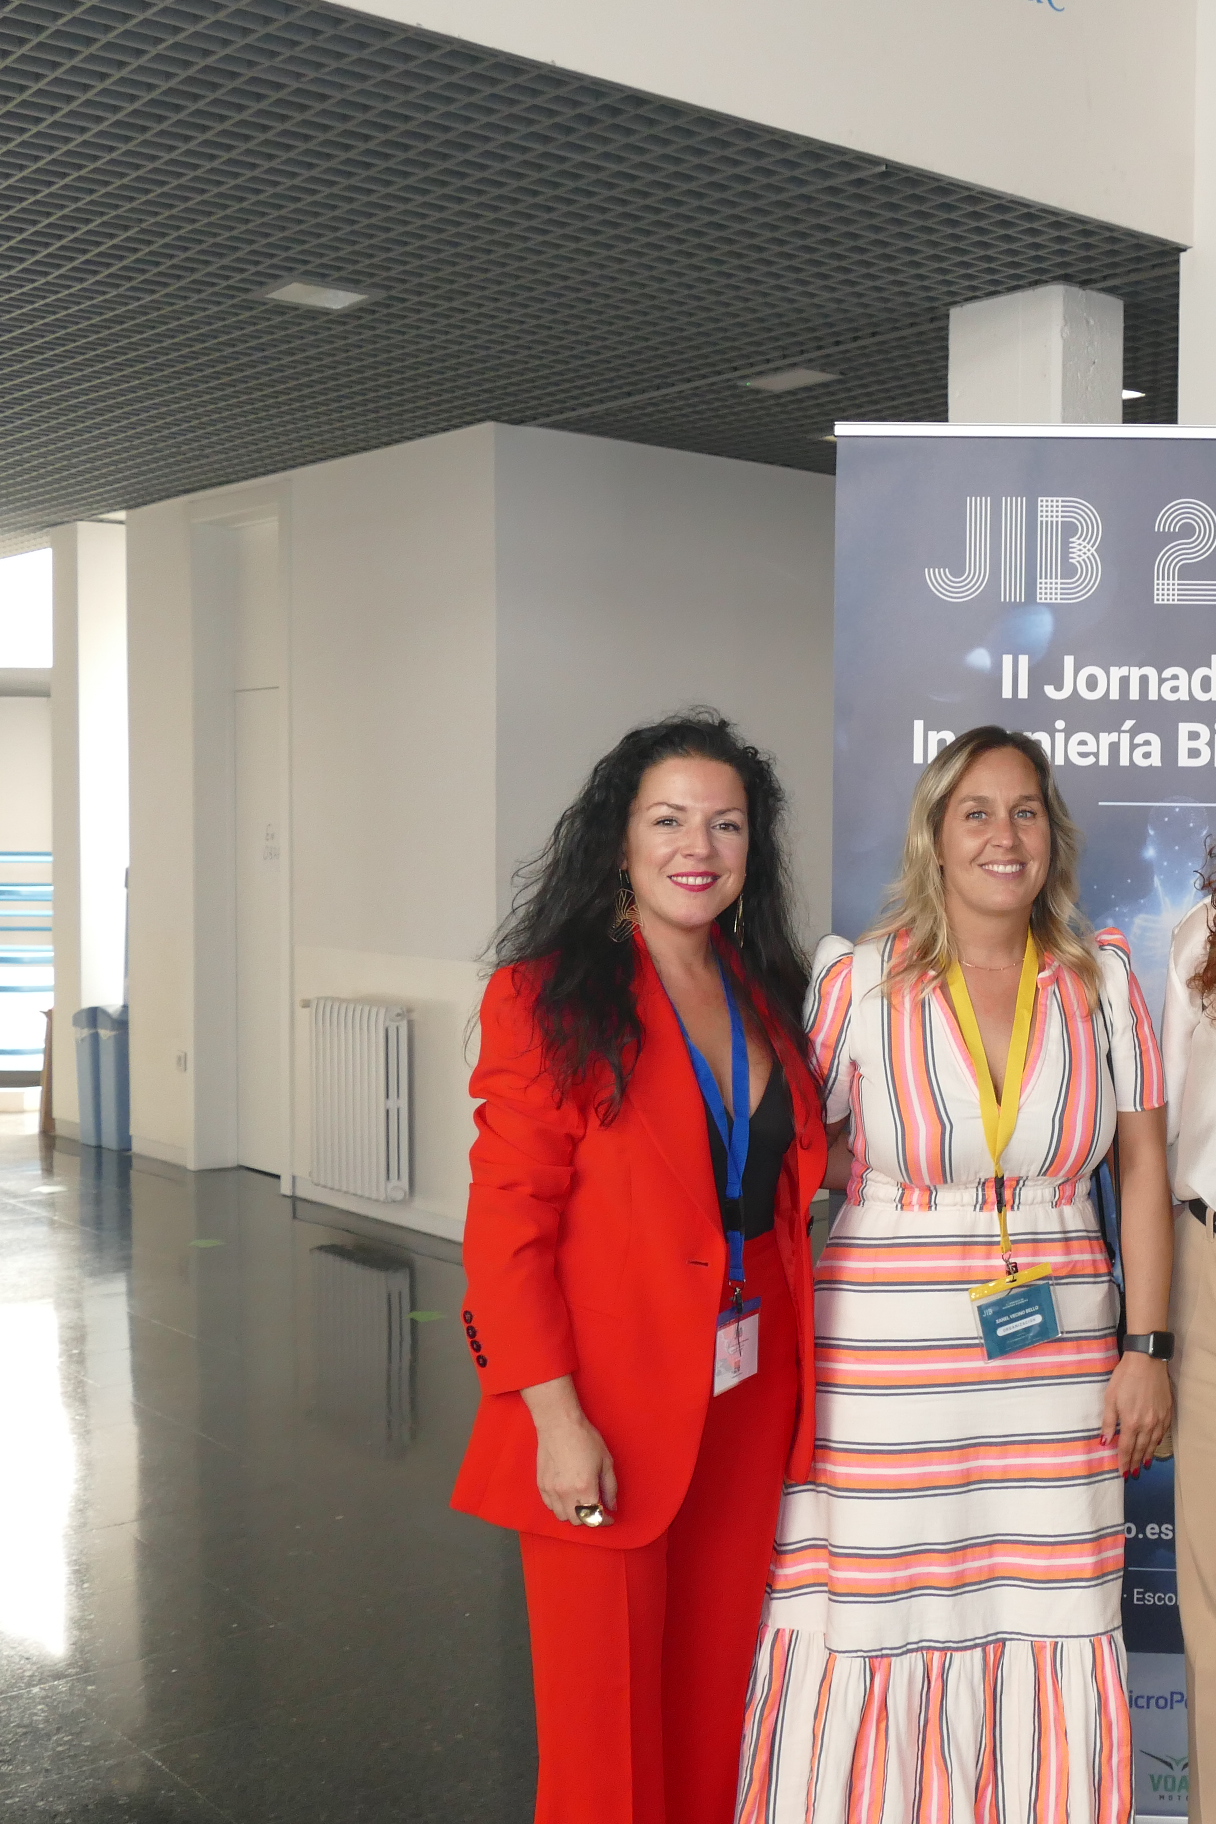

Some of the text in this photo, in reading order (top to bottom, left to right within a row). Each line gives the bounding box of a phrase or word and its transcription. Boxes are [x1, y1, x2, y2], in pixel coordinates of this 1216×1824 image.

[925, 496, 1101, 603] JIB
[1001, 654, 1029, 699] II
[913, 719, 1161, 768] Inniería
